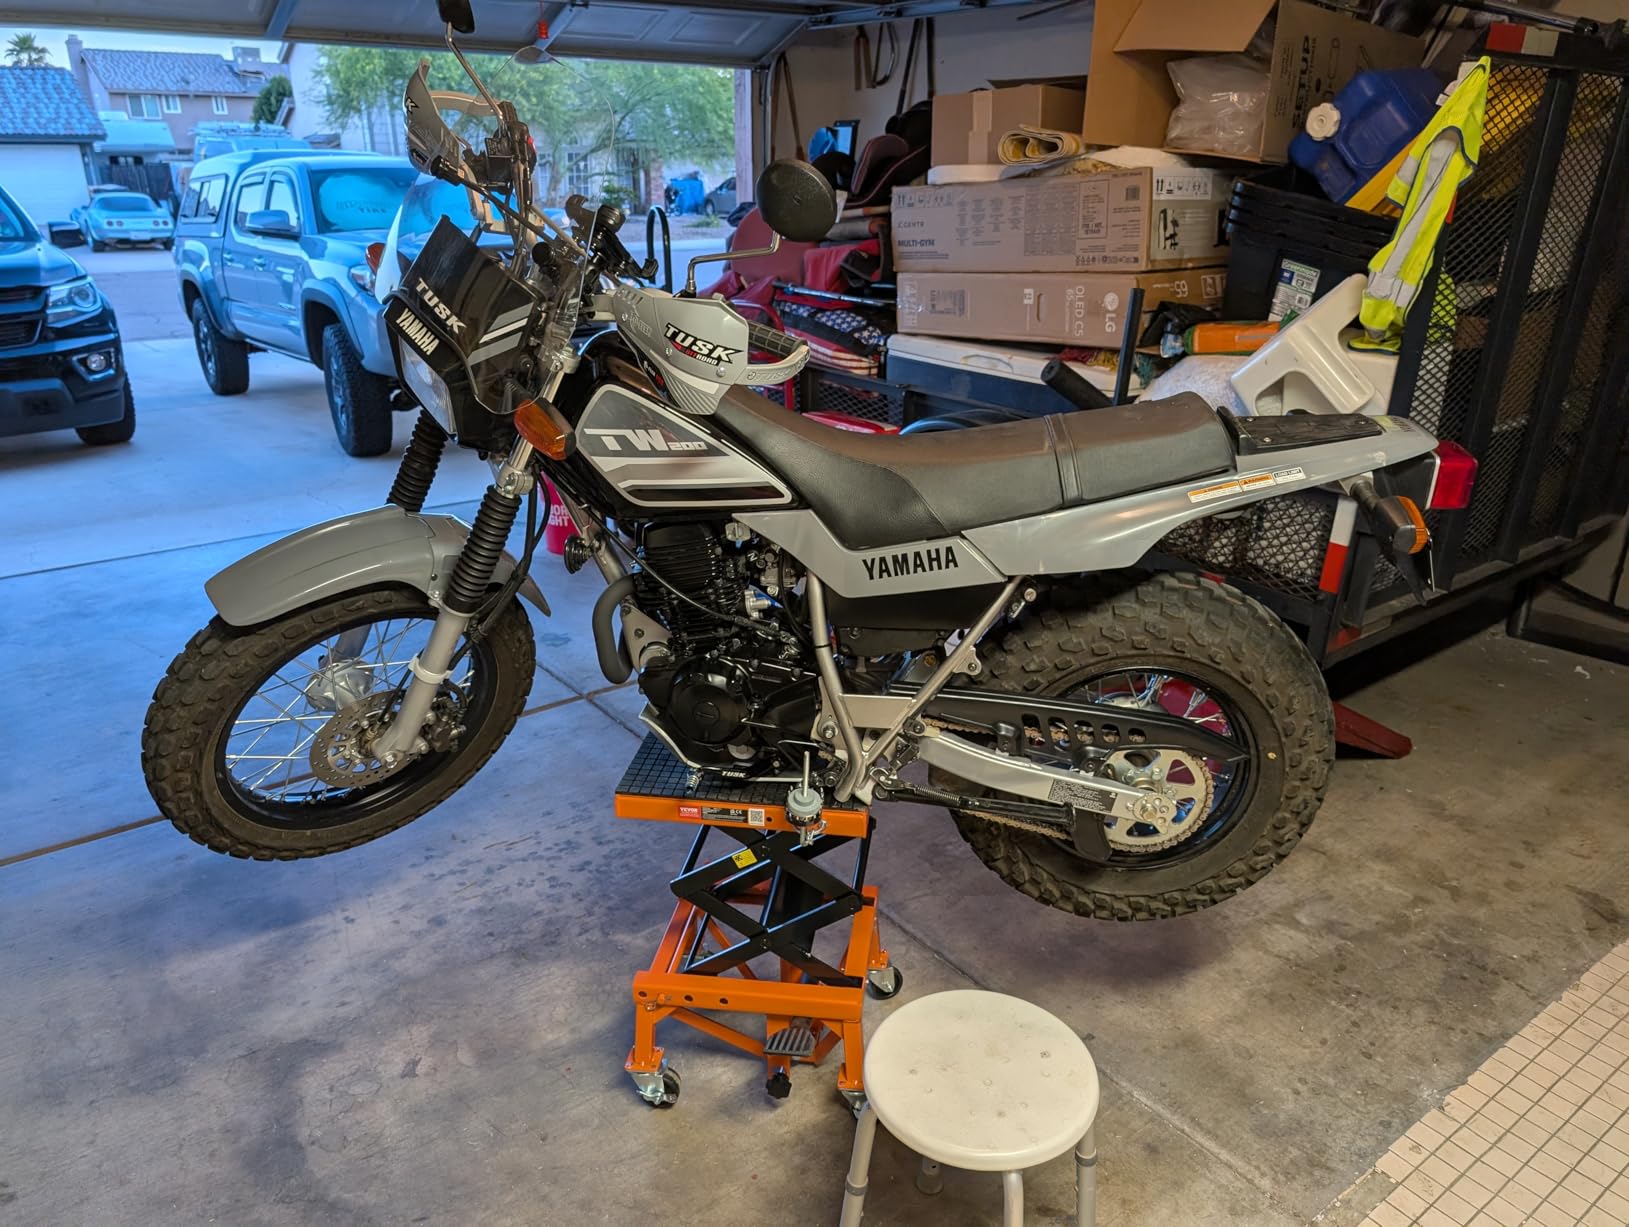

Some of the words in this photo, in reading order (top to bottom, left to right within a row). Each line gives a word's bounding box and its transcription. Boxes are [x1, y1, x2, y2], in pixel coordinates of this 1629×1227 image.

[898, 239, 935, 248] MULTI-GYM
[416, 278, 467, 334] TUSK
[1074, 285, 1086, 318] OLED
[396, 308, 440, 355] YAMAHA
[1074, 320, 1084, 337] C5
[1105, 313, 1117, 333] LG
[664, 323, 742, 363] TUSK
[862, 546, 959, 580] YAMAHA
